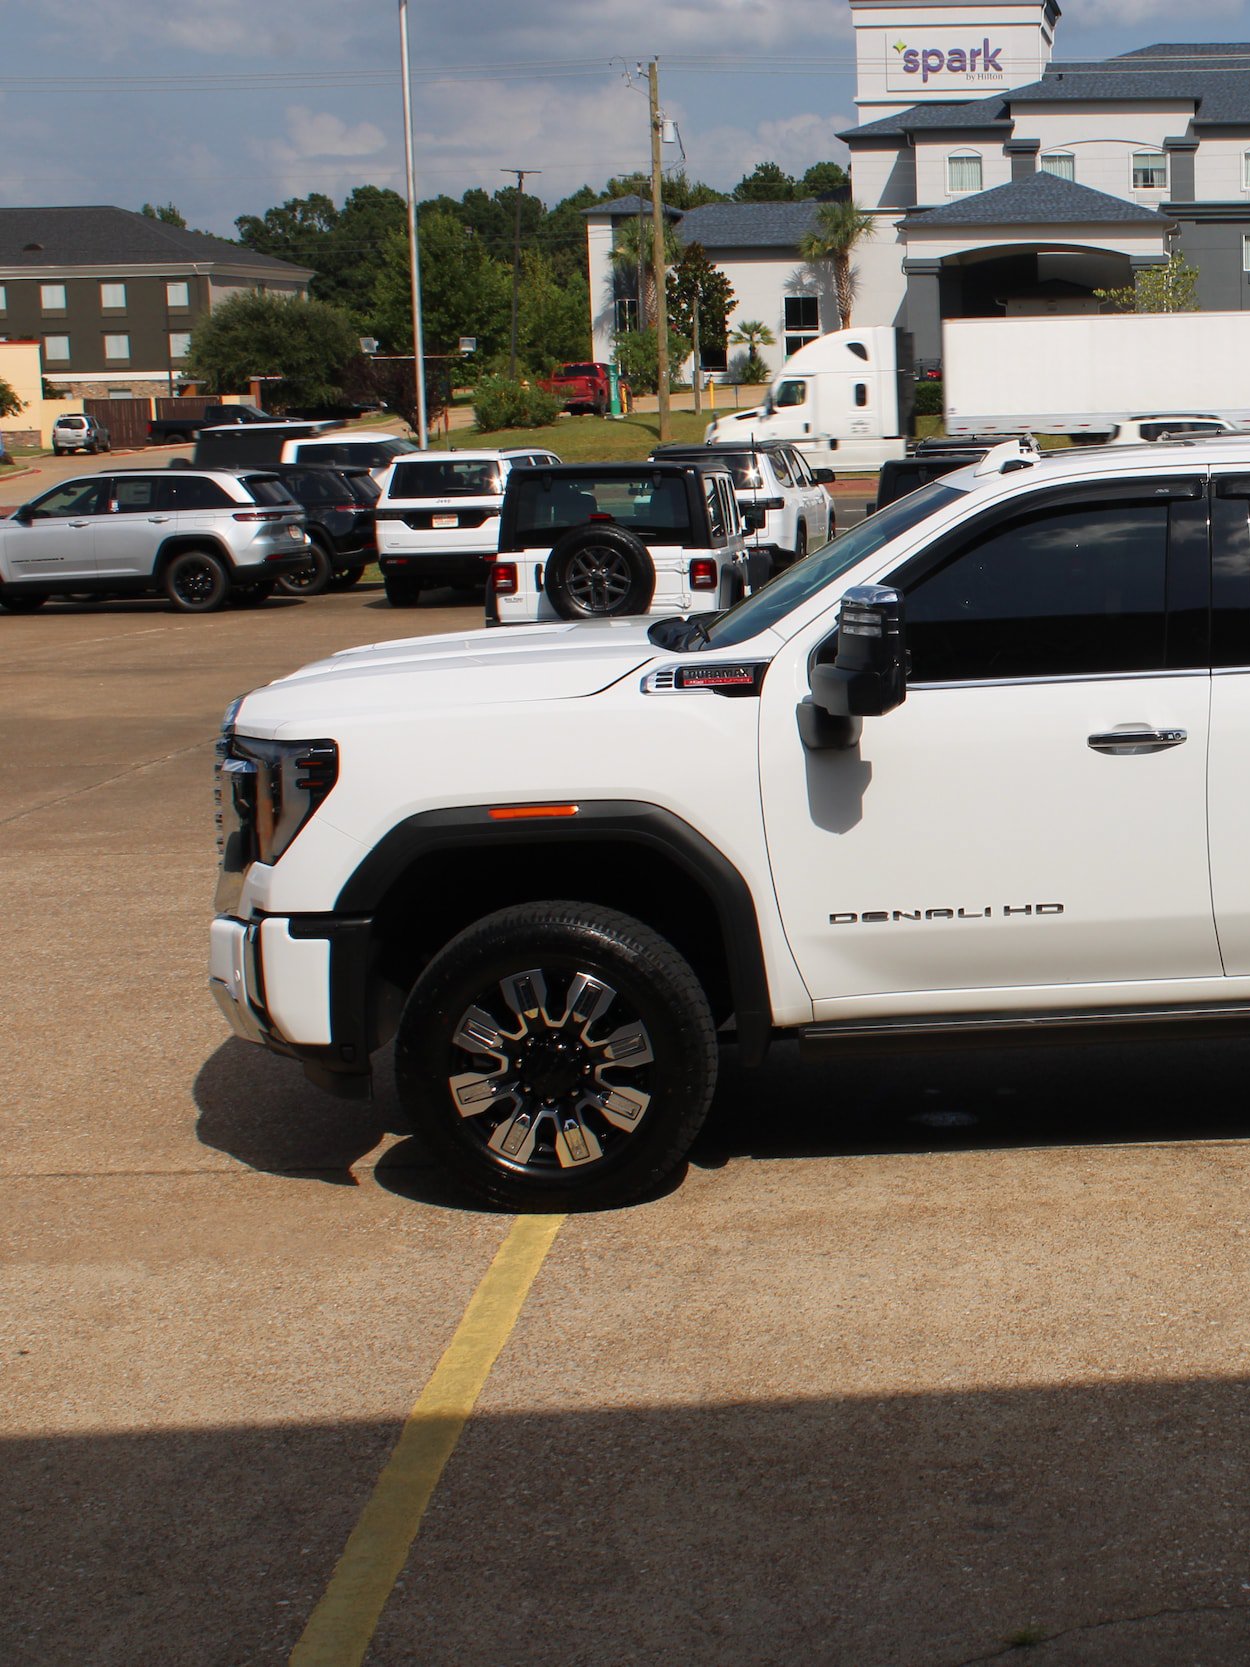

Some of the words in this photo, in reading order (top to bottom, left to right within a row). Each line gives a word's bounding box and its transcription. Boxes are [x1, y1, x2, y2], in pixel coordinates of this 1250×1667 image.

[903, 38, 1003, 83] spark
[966, 73, 975, 82] by
[829, 906, 991, 924] DENALI
[1003, 903, 1064, 916] HD
